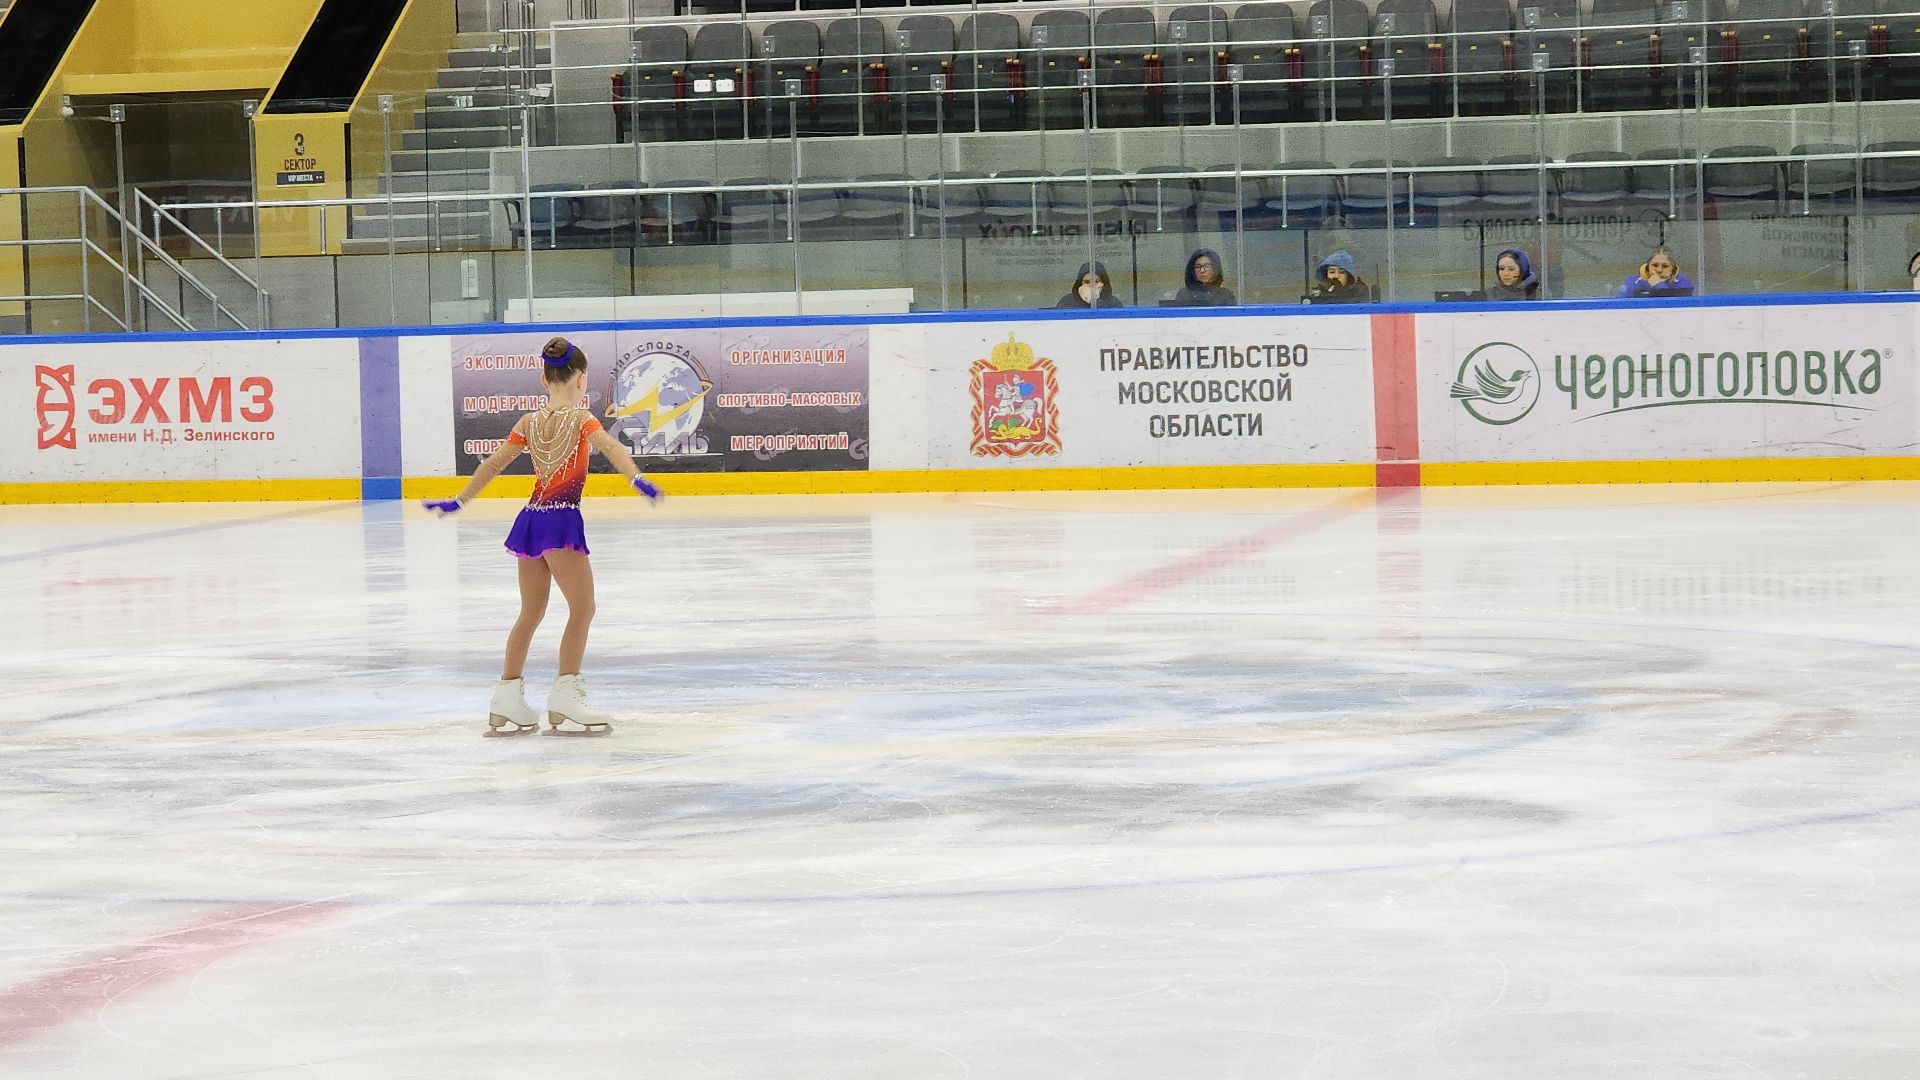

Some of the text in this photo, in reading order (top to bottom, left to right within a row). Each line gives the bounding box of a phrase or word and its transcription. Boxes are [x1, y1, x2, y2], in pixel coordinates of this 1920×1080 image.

[294, 133, 305, 156] 3
[284, 158, 317, 171] СЕКТОР
[609, 341, 690, 379] МИР СПОРТА
[730, 349, 847, 367] ОРГАНИЗАЦИЯ
[1099, 343, 1309, 372] ПРАВИТЕЛЬСТВО
[87, 376, 274, 424] ЭХМЗ
[717, 391, 862, 408] СПОРТИВНО-МАССОВЫХ
[1117, 373, 1293, 405] МОСКОВСКОЙ
[88, 427, 275, 445] имени Н.Д. Зелинского
[1149, 413, 1263, 438] ОБЛАСТИ
[730, 431, 849, 451] МЕРОПРИЯТИЙ
